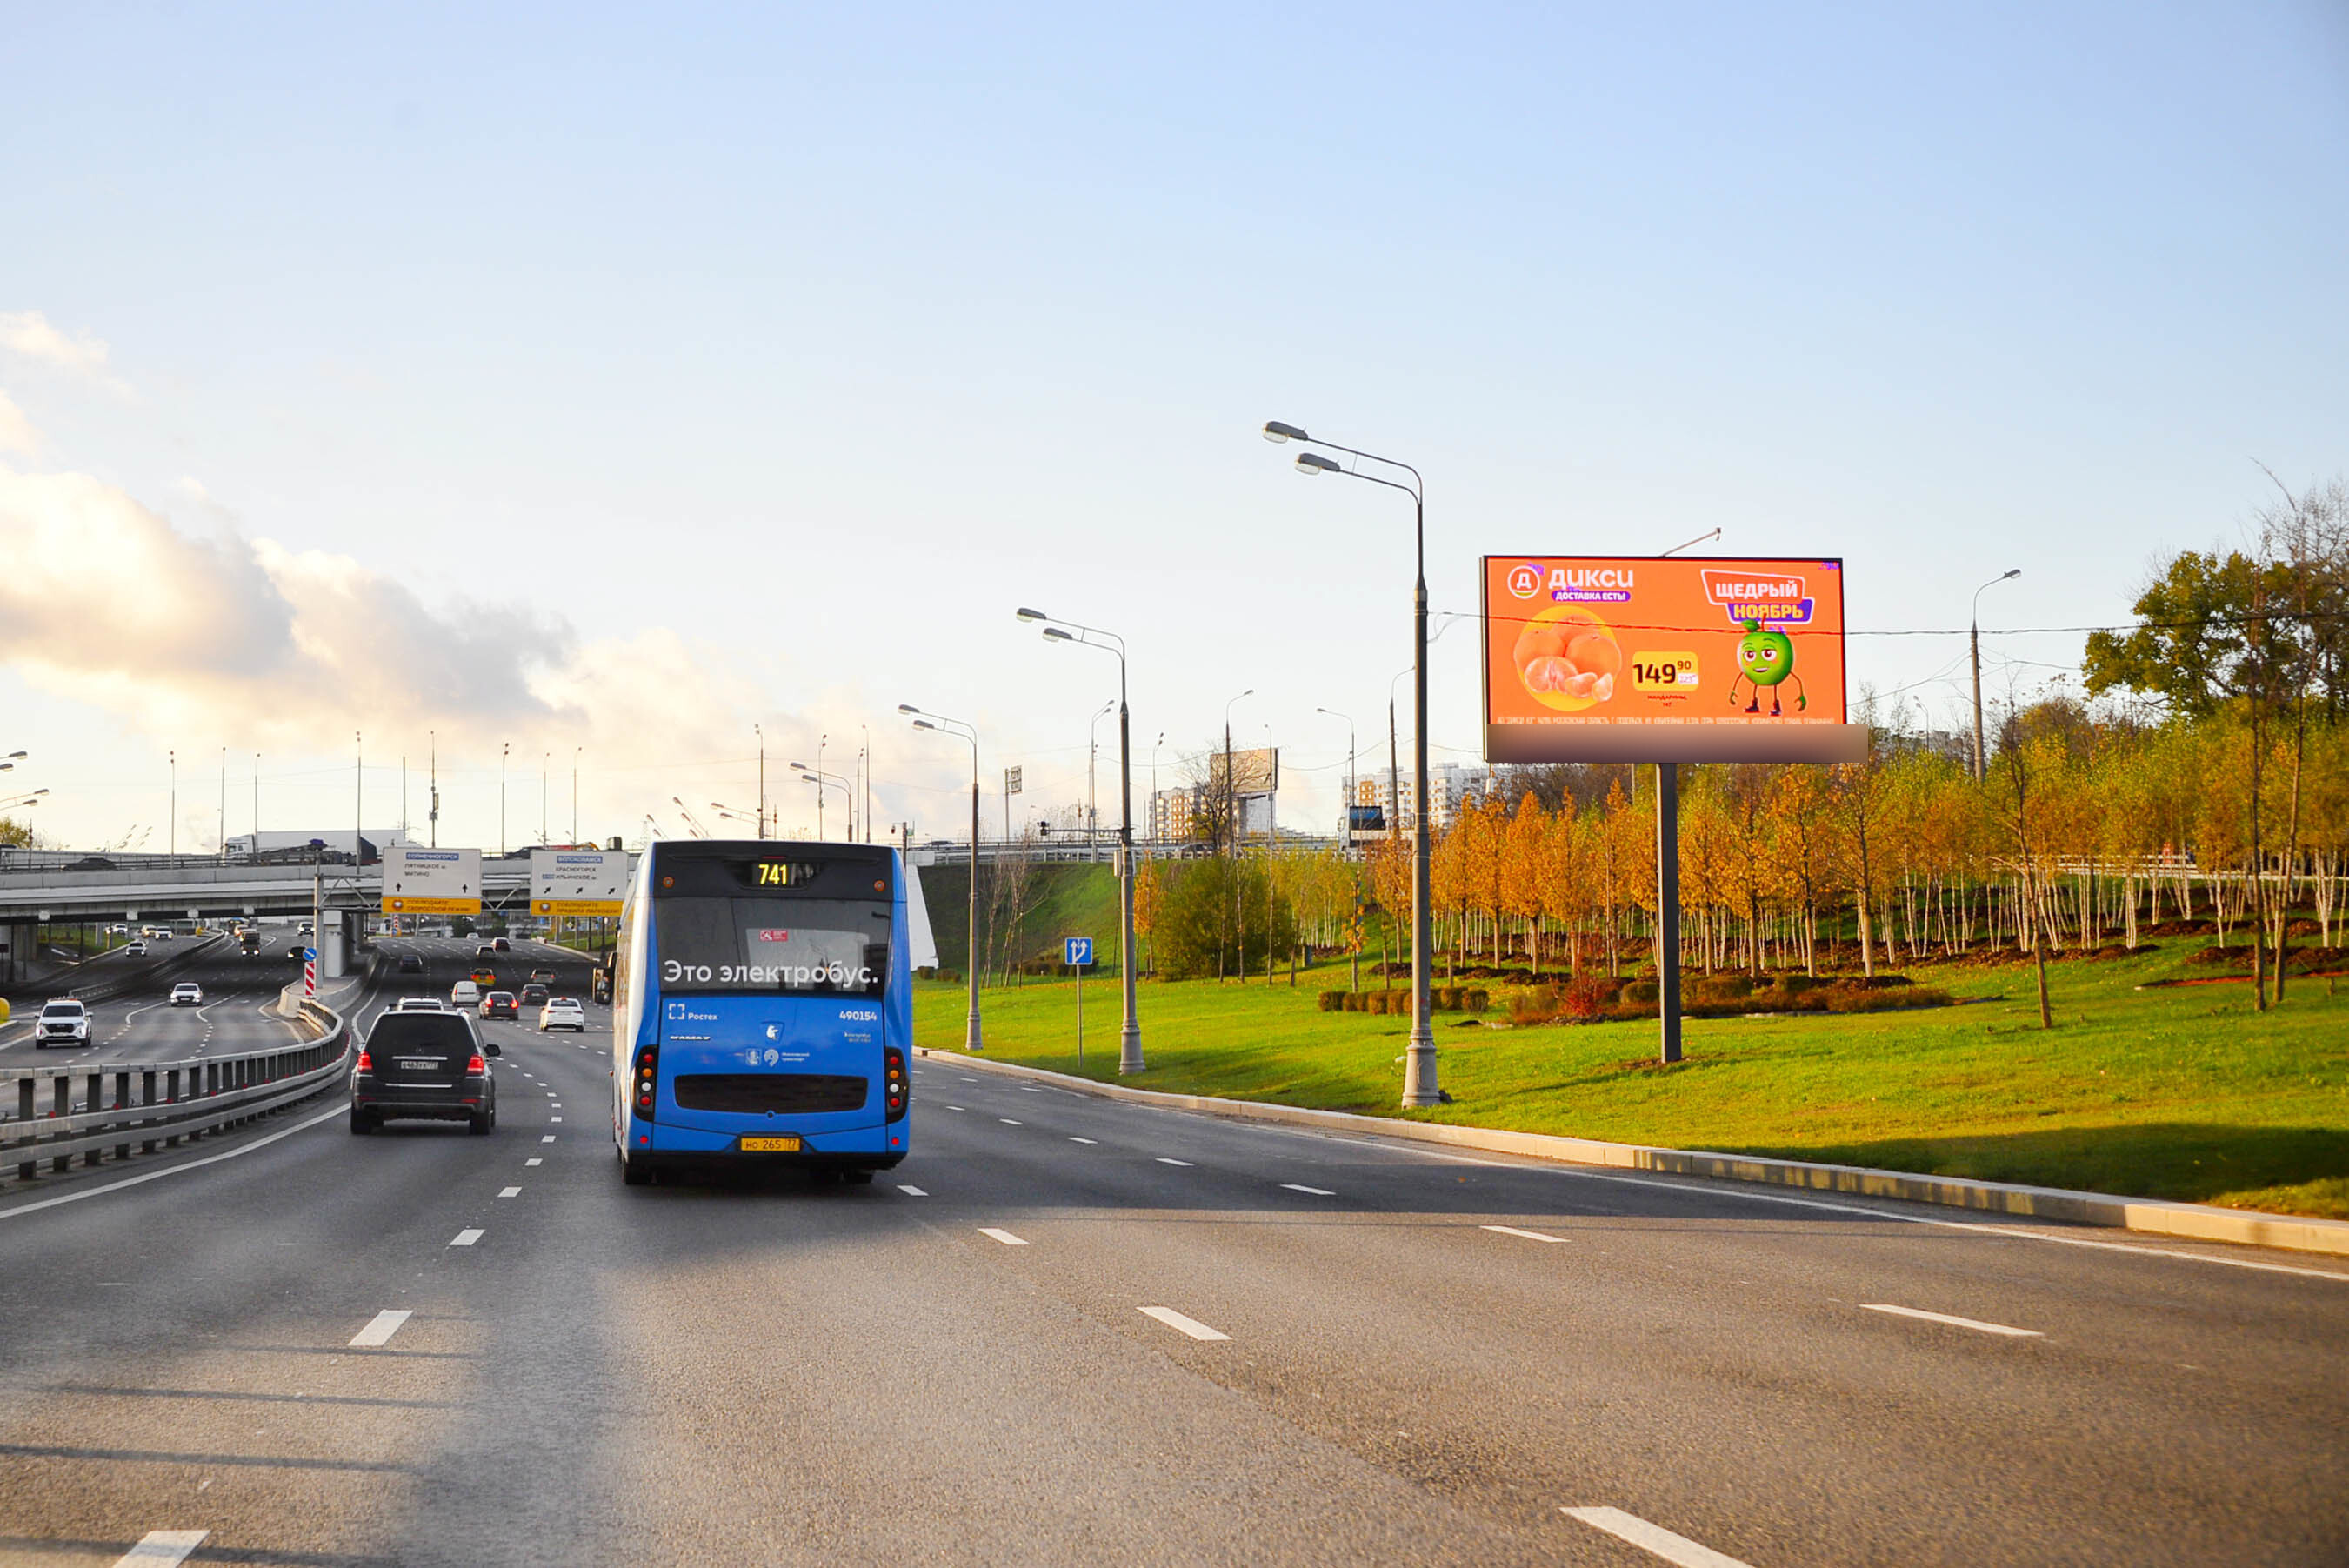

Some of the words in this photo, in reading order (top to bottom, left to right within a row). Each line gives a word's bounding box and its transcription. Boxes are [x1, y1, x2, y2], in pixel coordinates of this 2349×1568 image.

[1555, 591, 1601, 601] ДОСТАВКА
[1715, 580, 1798, 599] ЩЕДРЫЙ
[1733, 604, 1804, 619] НОЯБРЬ
[1632, 664, 1676, 684] 149
[1678, 660, 1692, 670] 90
[758, 864, 787, 884] 741
[664, 959, 712, 983] Это
[719, 960, 878, 988] электробус.
[687, 1012, 718, 1021] Ростех
[838, 1011, 878, 1021] 490154
[763, 1139, 781, 1149] 265
